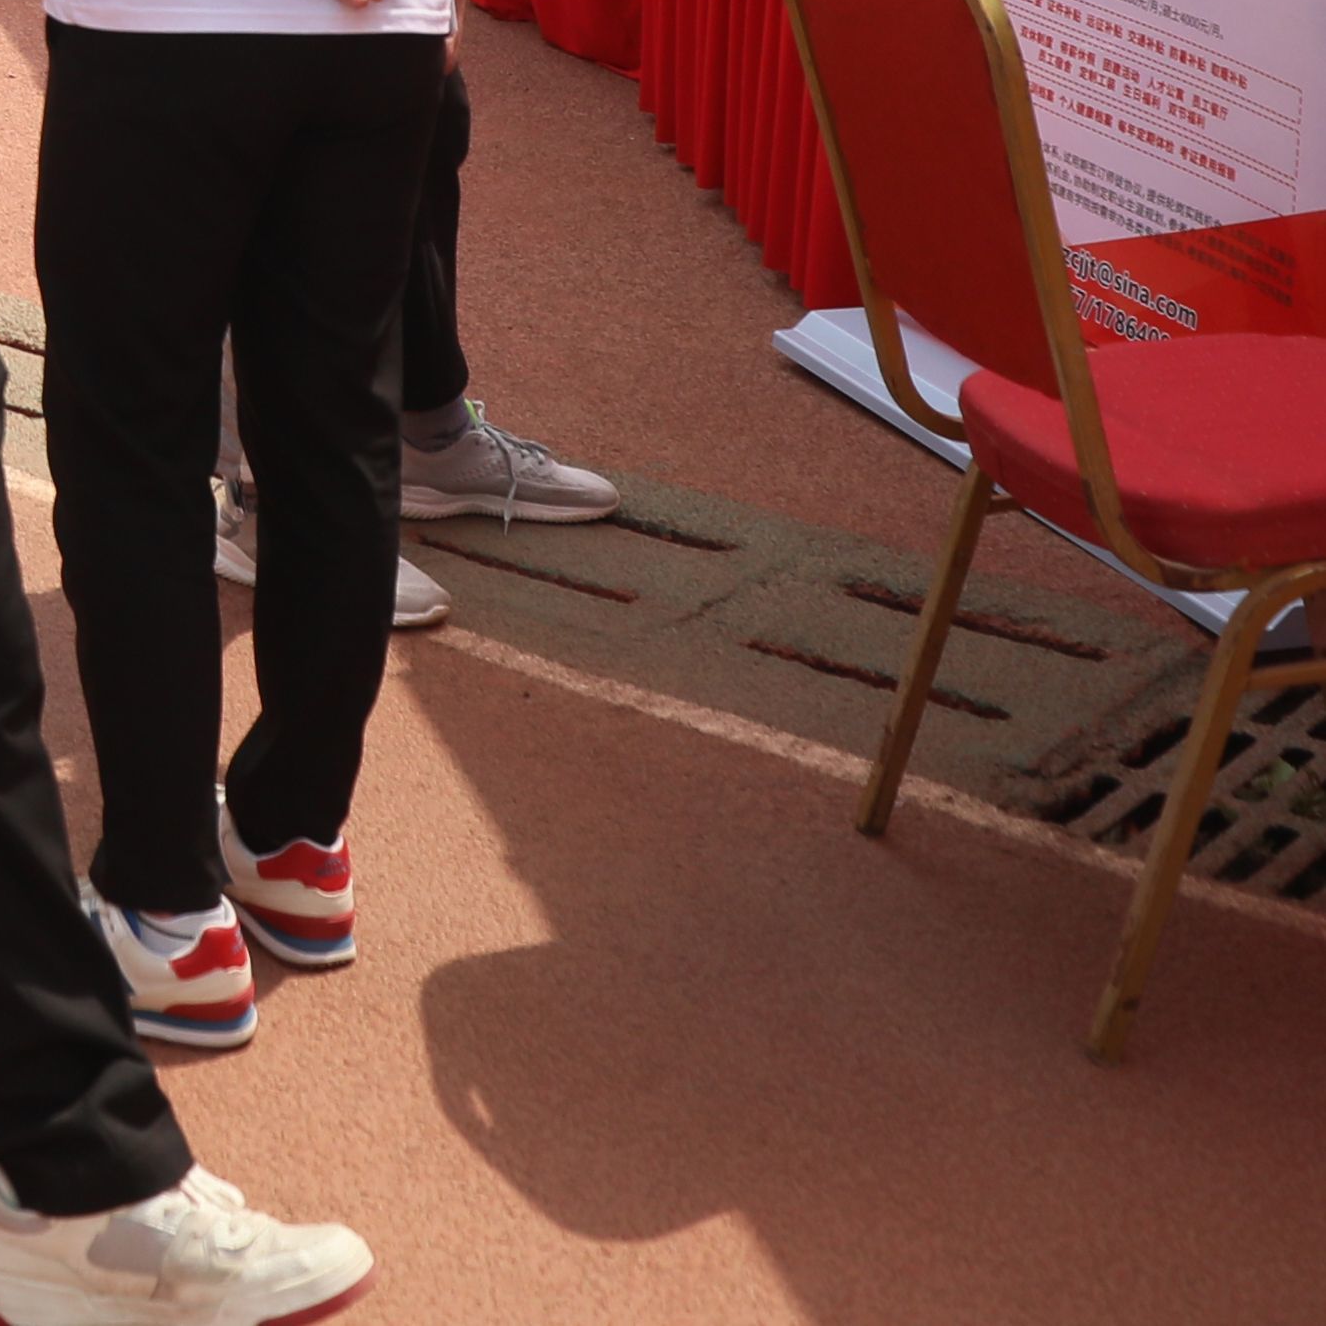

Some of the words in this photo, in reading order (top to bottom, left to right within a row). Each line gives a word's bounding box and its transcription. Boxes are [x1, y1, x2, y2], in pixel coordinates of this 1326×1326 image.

[1128, 23, 1166, 55] 交通补贴
[1123, 82, 1162, 111] 生日福利
[1148, 74, 1185, 104] 人才公寓
[1059, 94, 1114, 128] 个人健康档案
